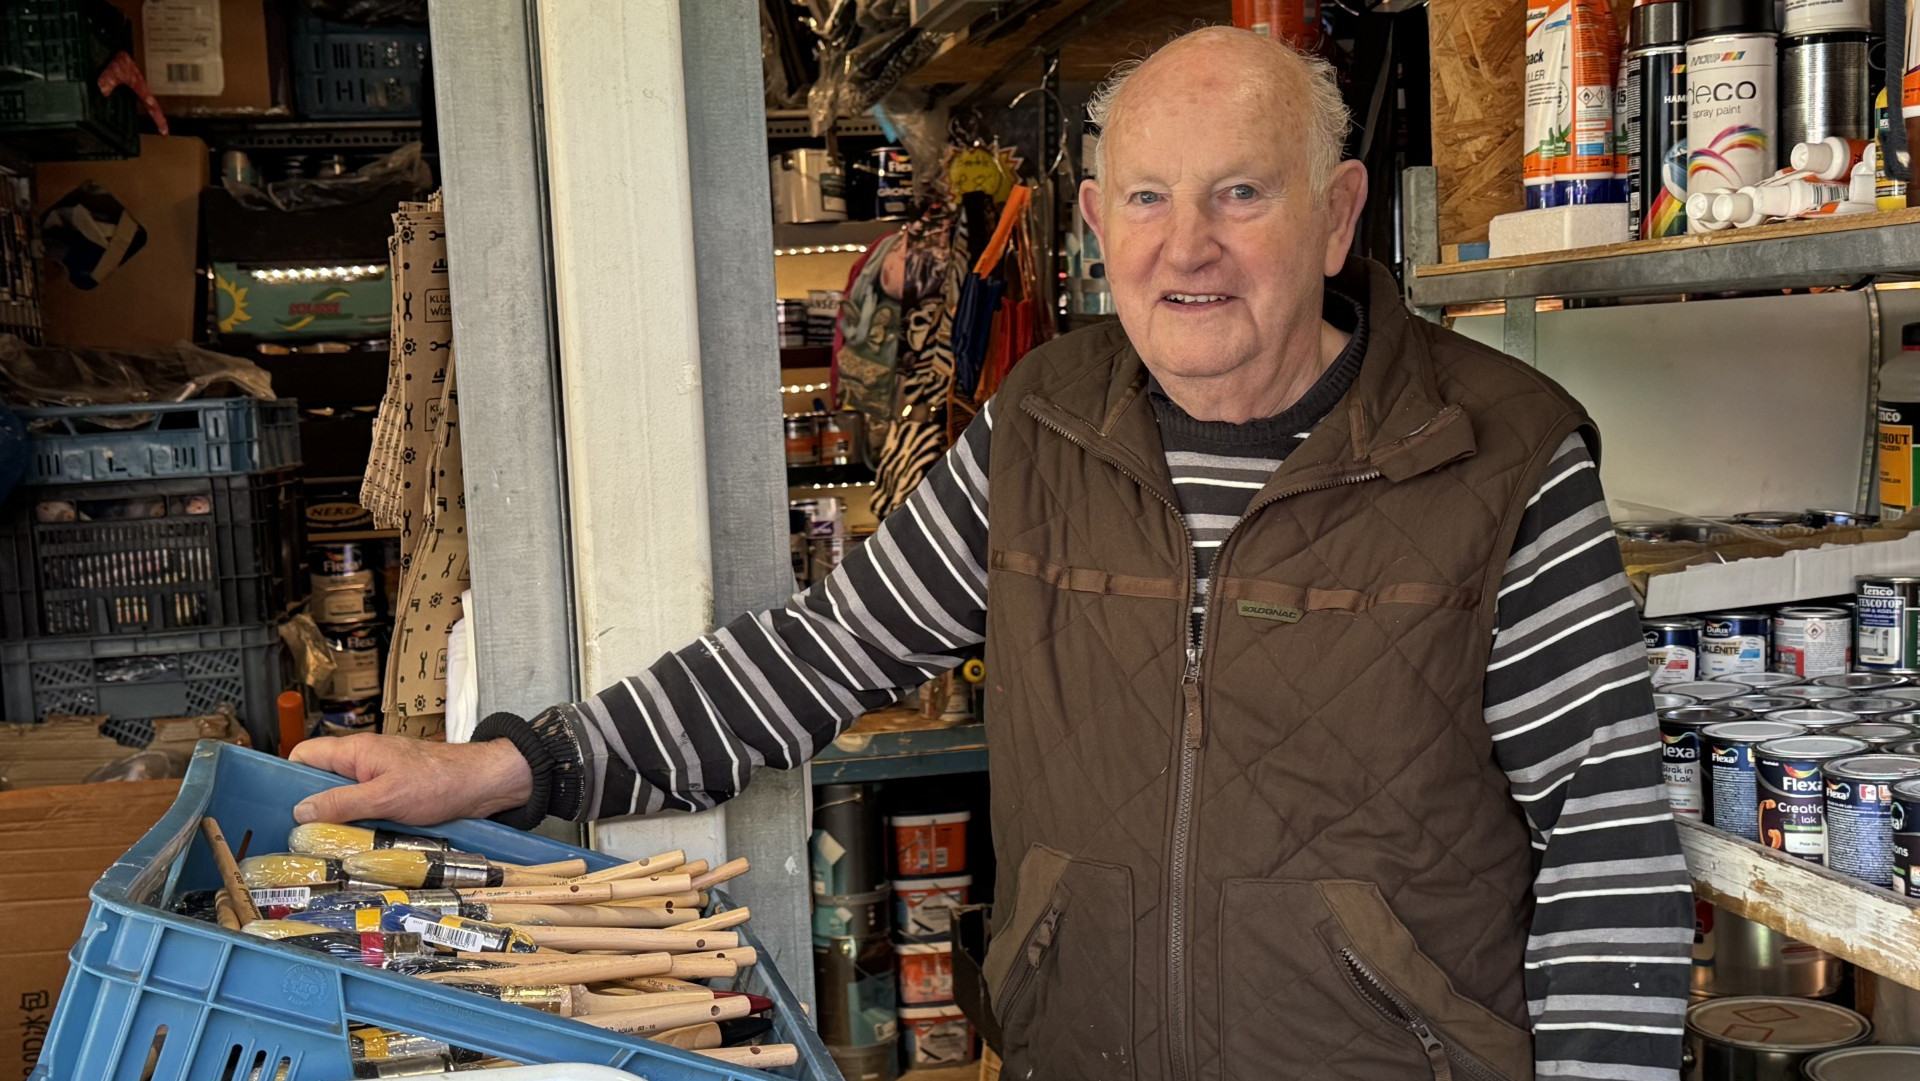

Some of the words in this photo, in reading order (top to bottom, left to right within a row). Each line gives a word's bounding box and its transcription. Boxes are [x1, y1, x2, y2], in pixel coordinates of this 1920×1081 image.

[1692, 109, 1713, 119] spray
[1716, 105, 1741, 117] paint
[1862, 583, 1894, 596] tenco
[1241, 605, 1297, 619] SOLOGNAC
[1711, 752, 1735, 764] Flexa
[1674, 775, 1691, 783] Lak
[1826, 787, 1846, 800] Flexa
[1801, 815, 1816, 824] lak
